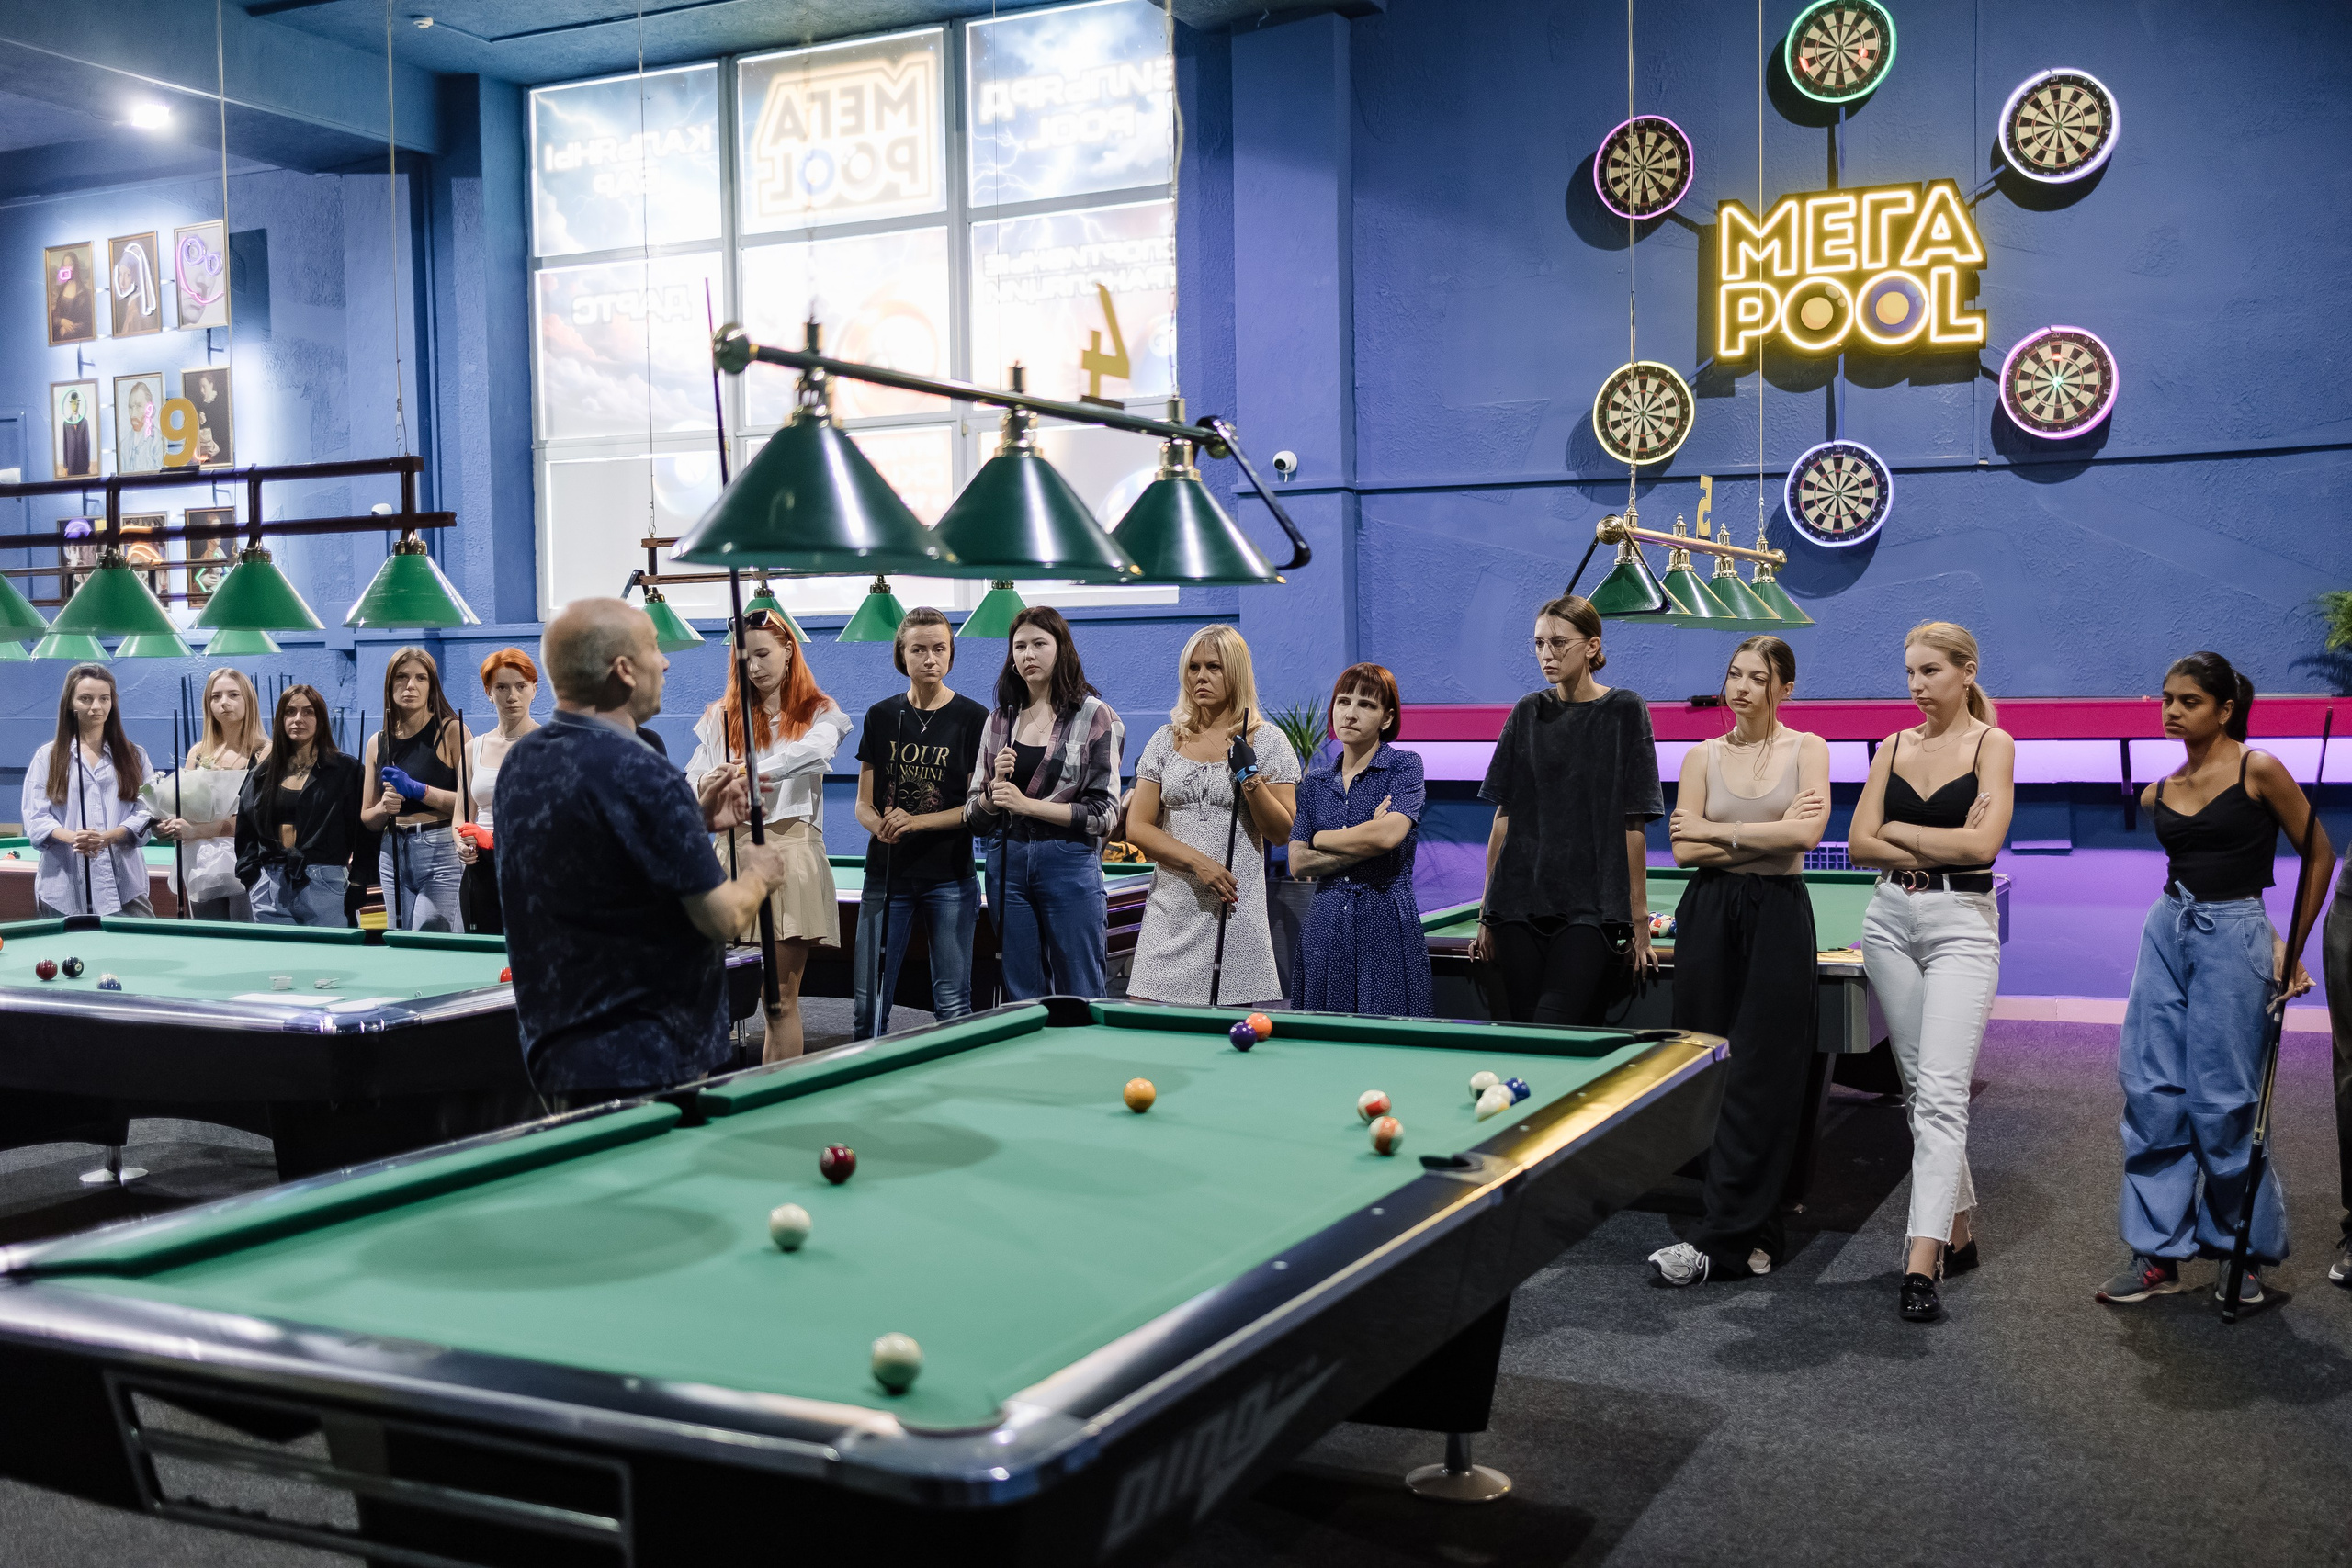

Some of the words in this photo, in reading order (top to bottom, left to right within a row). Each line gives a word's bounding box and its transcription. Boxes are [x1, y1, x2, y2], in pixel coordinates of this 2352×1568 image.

[1721, 185, 1984, 280] МЕГА
[1719, 265, 1984, 356] POOL
[159, 397, 199, 468] 9
[889, 740, 950, 767] YOUR
